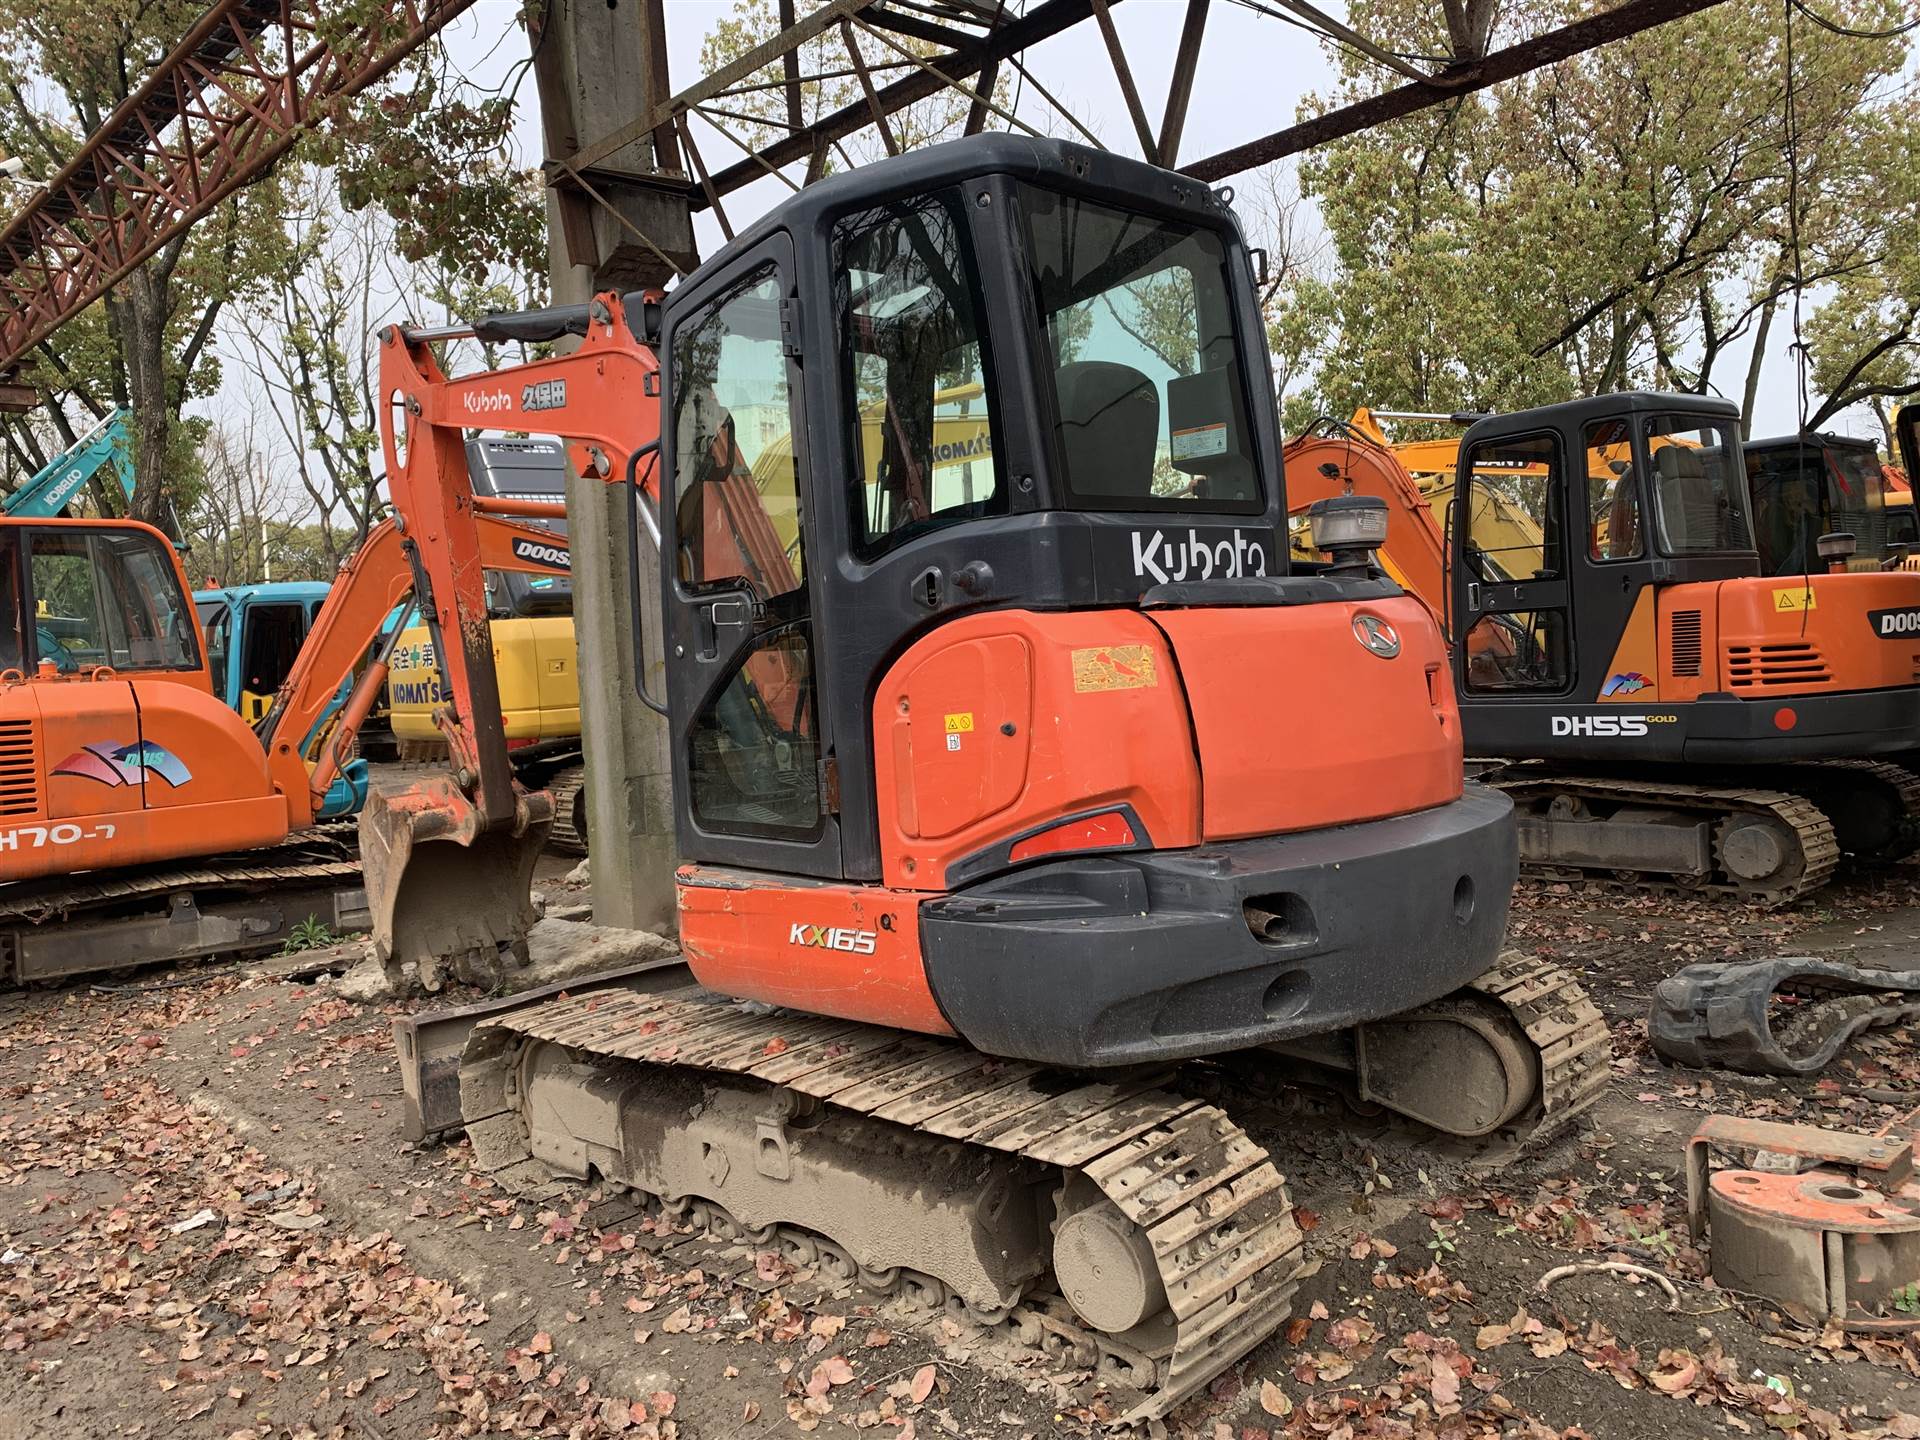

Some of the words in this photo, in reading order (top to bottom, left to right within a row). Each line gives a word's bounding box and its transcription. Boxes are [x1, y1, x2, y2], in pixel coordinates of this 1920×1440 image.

[463, 388, 512, 413] Kubota
[521, 379, 566, 412] 久保田
[43, 469, 82, 506] KOBELCO
[516, 542, 571, 566] DOOS
[1131, 528, 1266, 585] Kubota
[1881, 612, 1920, 634] DOO
[1551, 715, 1649, 737] DH55
[1646, 715, 1678, 723] GOLD
[0, 824, 116, 850] H70-7
[789, 923, 877, 955] KX165
